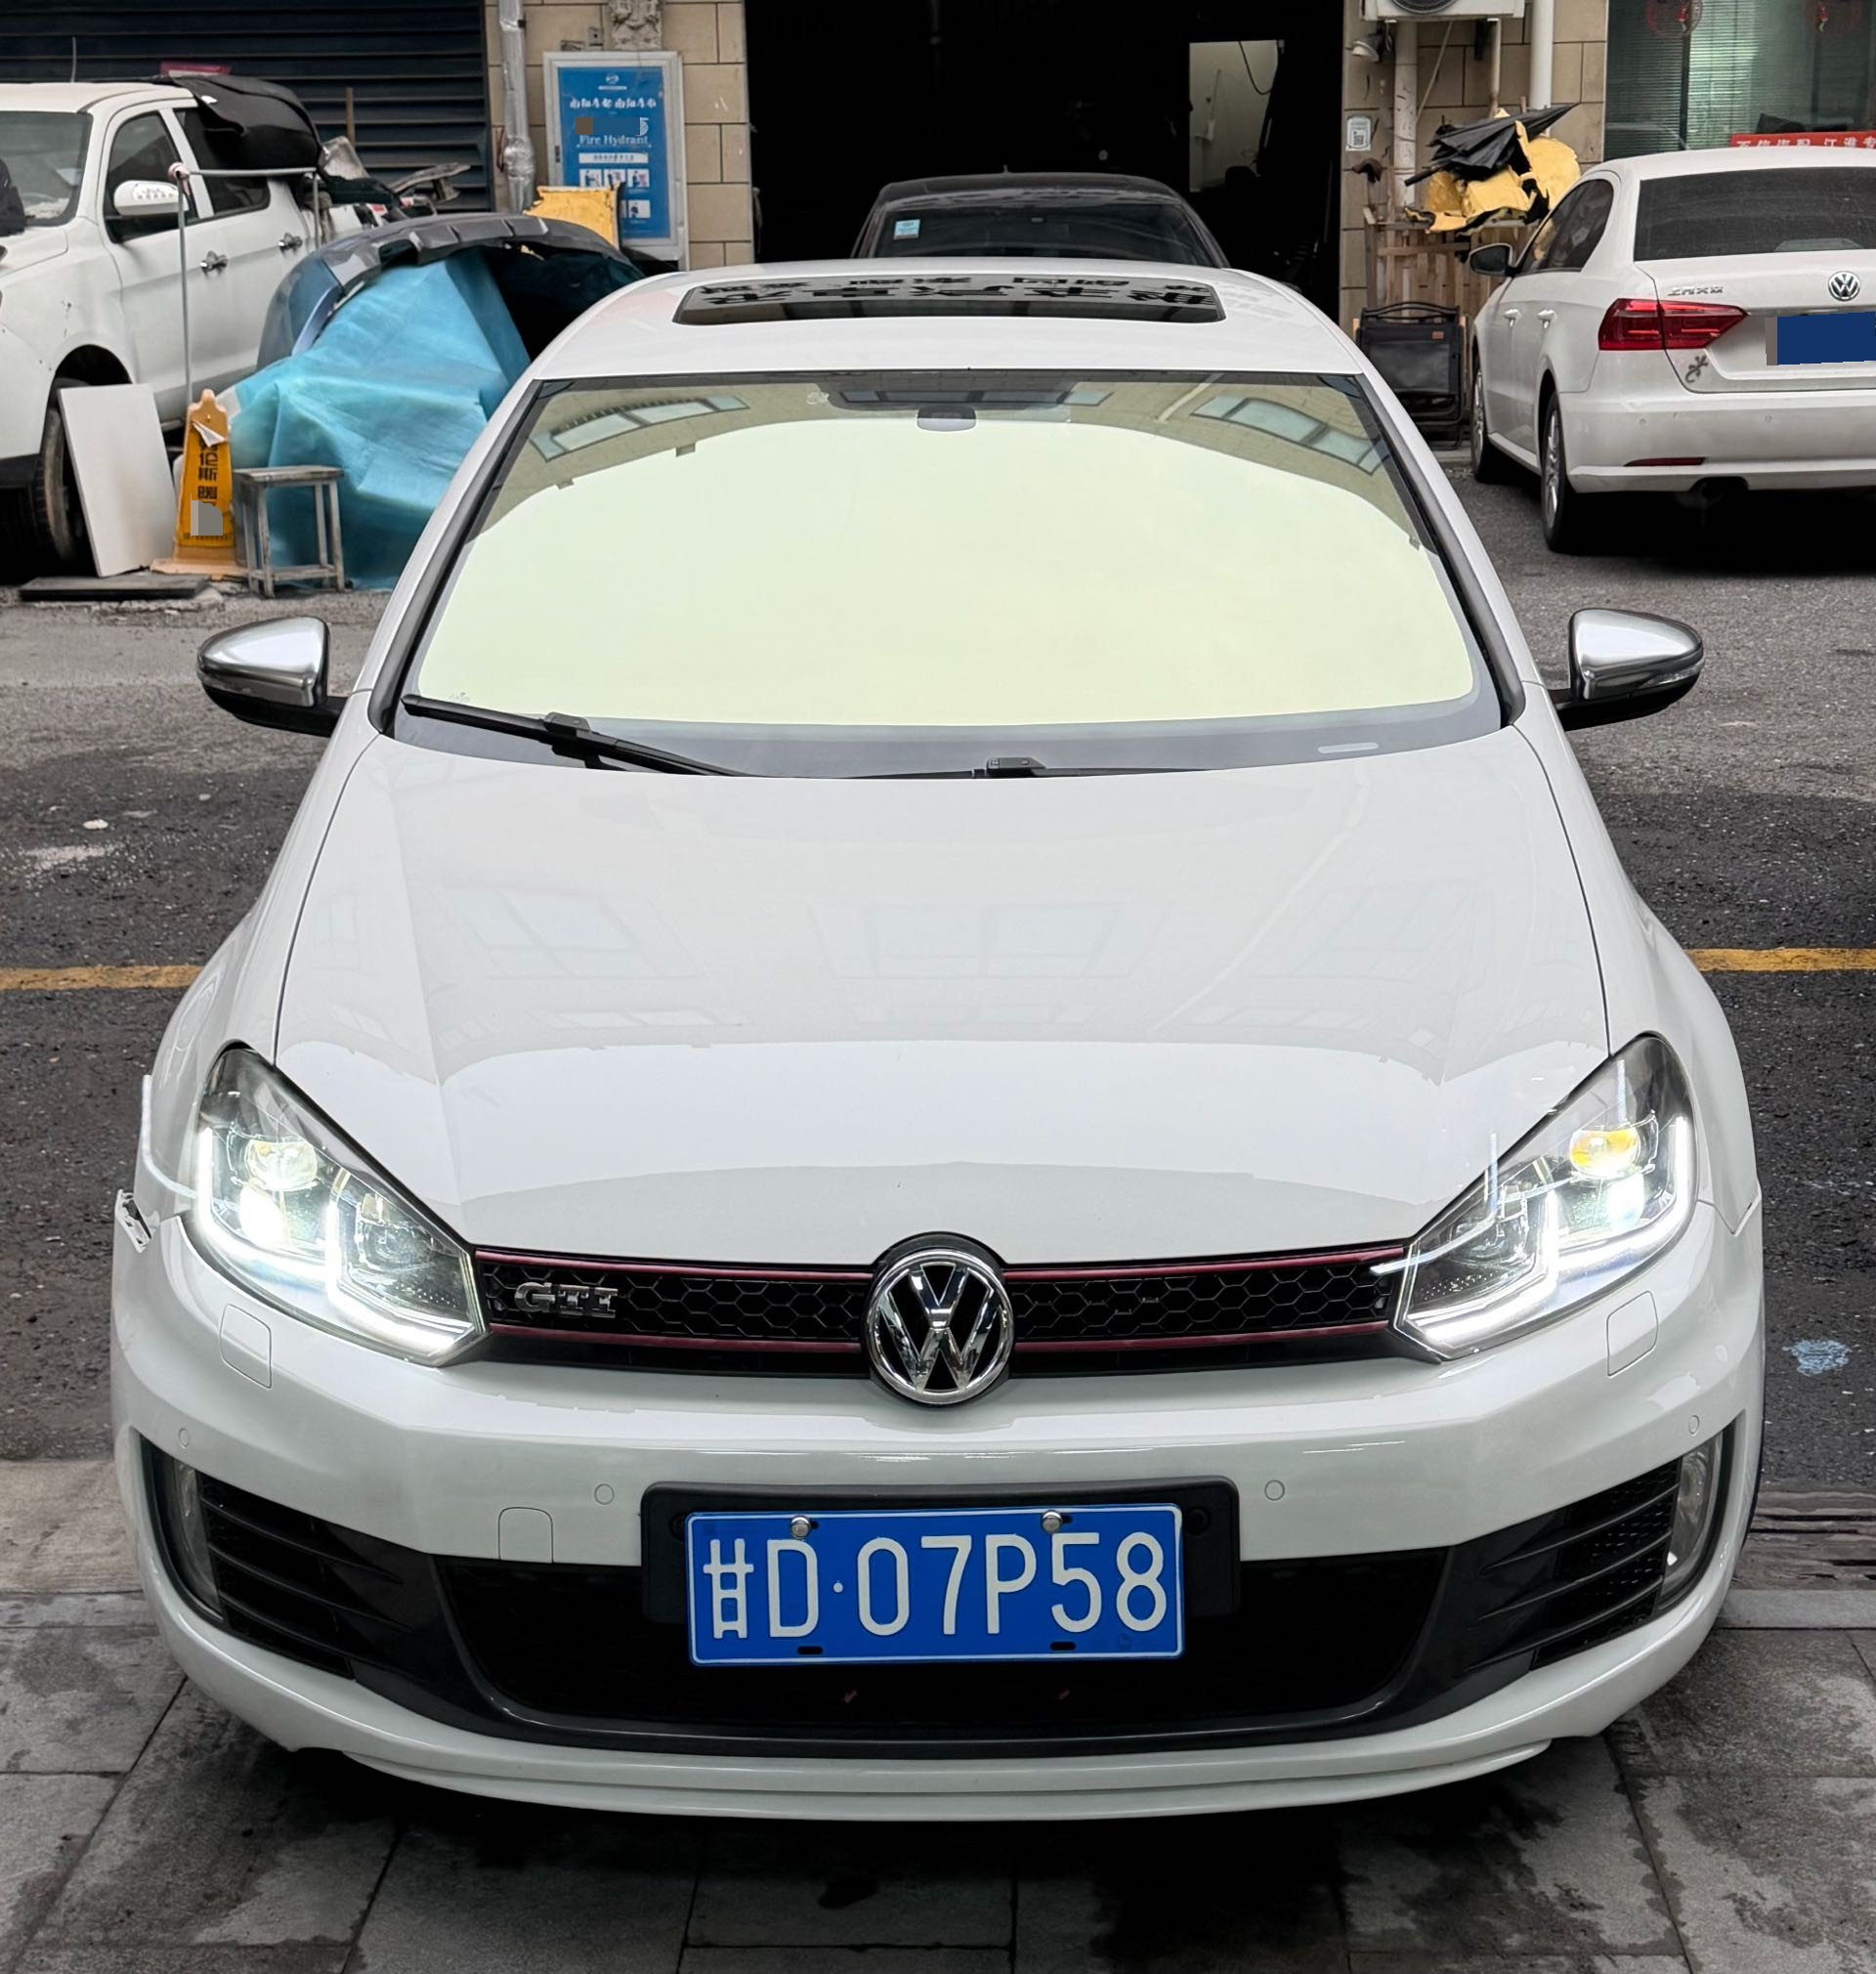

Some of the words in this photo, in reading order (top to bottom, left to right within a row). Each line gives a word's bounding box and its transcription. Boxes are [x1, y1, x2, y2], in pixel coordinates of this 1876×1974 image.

[578, 135, 601, 145] Fire
[604, 135, 648, 147] Hydrant
[514, 1281, 618, 1319] GTI
